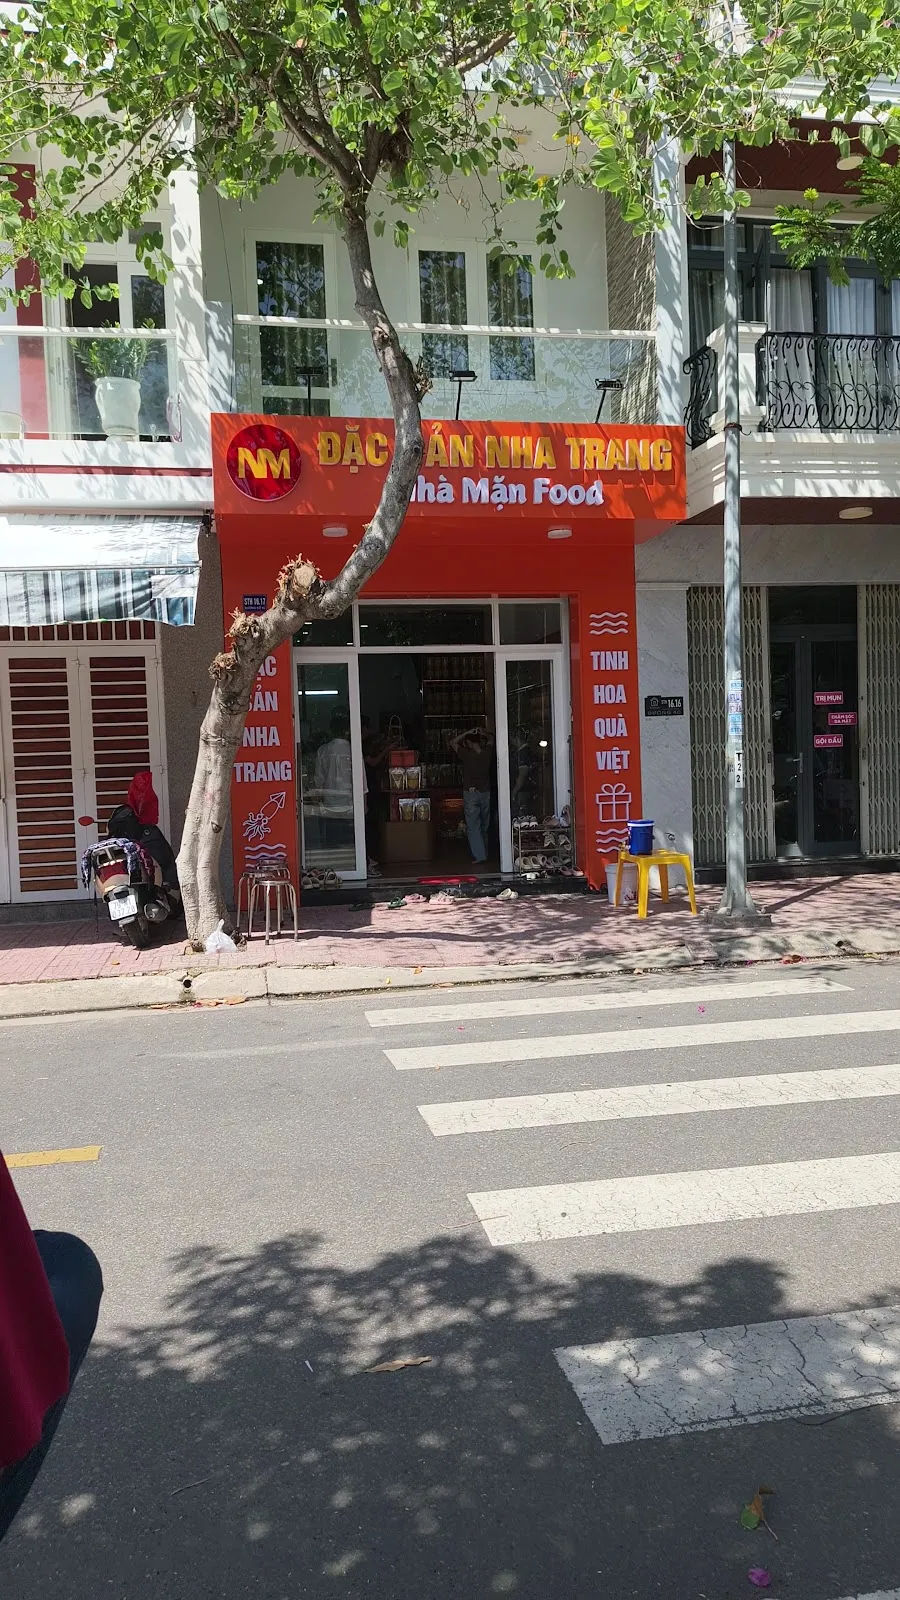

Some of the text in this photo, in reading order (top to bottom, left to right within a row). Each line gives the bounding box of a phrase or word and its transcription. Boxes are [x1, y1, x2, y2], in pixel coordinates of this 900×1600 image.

[316, 421, 673, 474] ĐẶC ẢN NHA TRANG
[461, 474, 527, 511] Mặn
[532, 477, 605, 506] Food
[590, 650, 629, 671] TINH
[248, 684, 279, 712] ẢN
[593, 684, 627, 704] HOA
[668, 699, 682, 708] 16.16
[815, 695, 826, 703] TRỊ
[242, 726, 281, 748] NHA
[594, 713, 628, 740] QUÀ
[815, 737, 827, 745] GỘI
[233, 760, 293, 783] TRANG
[596, 747, 630, 774] VIỆT
